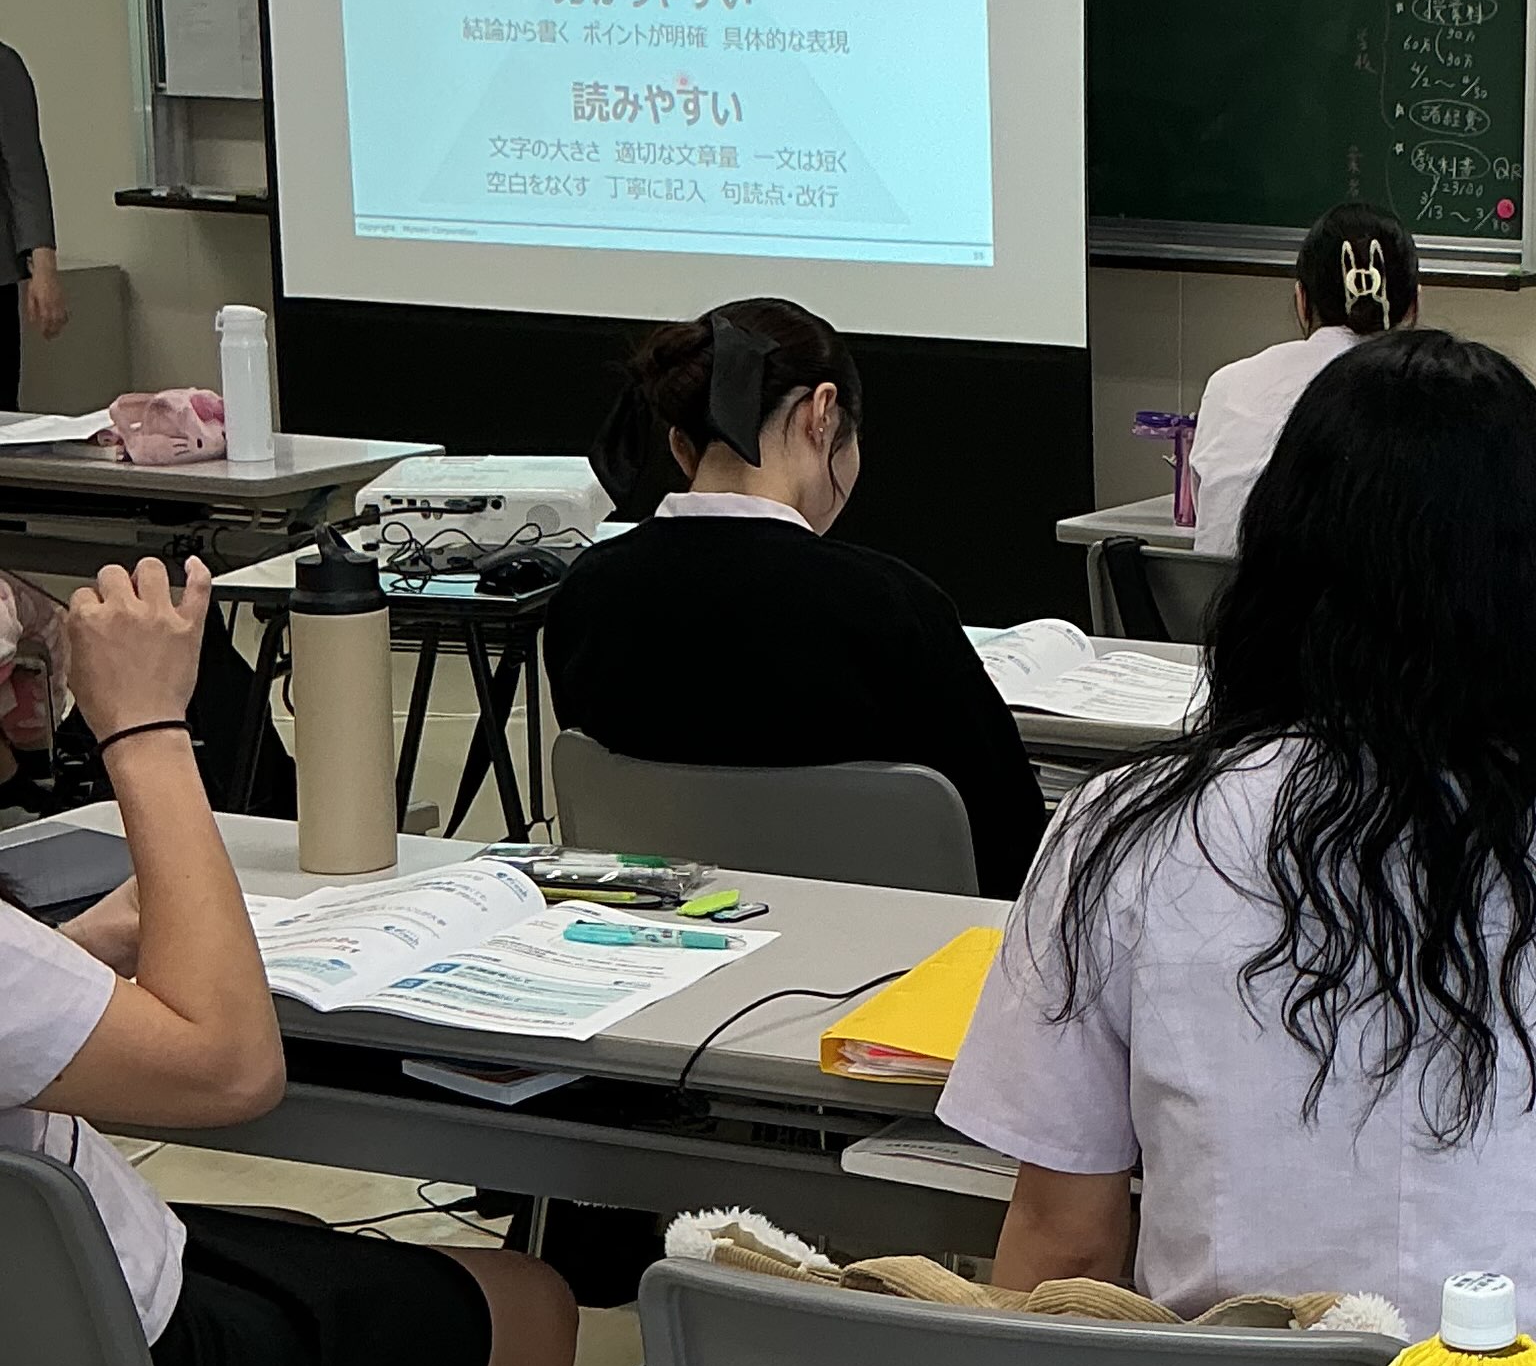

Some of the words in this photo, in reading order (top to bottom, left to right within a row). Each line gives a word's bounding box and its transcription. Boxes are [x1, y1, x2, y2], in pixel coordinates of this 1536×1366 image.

[462, 16, 568, 44] 結論から書く
[583, 21, 708, 49] ポイントが明確
[722, 26, 850, 55] 具体的な表現
[571, 80, 743, 127] 読みやすい
[488, 135, 600, 162] 文字の大きさ
[614, 139, 740, 169] 適切な文章量
[753, 148, 848, 173] 一文は短く
[486, 170, 590, 197] 空白をなくす
[605, 175, 705, 204] 丁寧に記入
[720, 179, 840, 208] 句読点・改行
